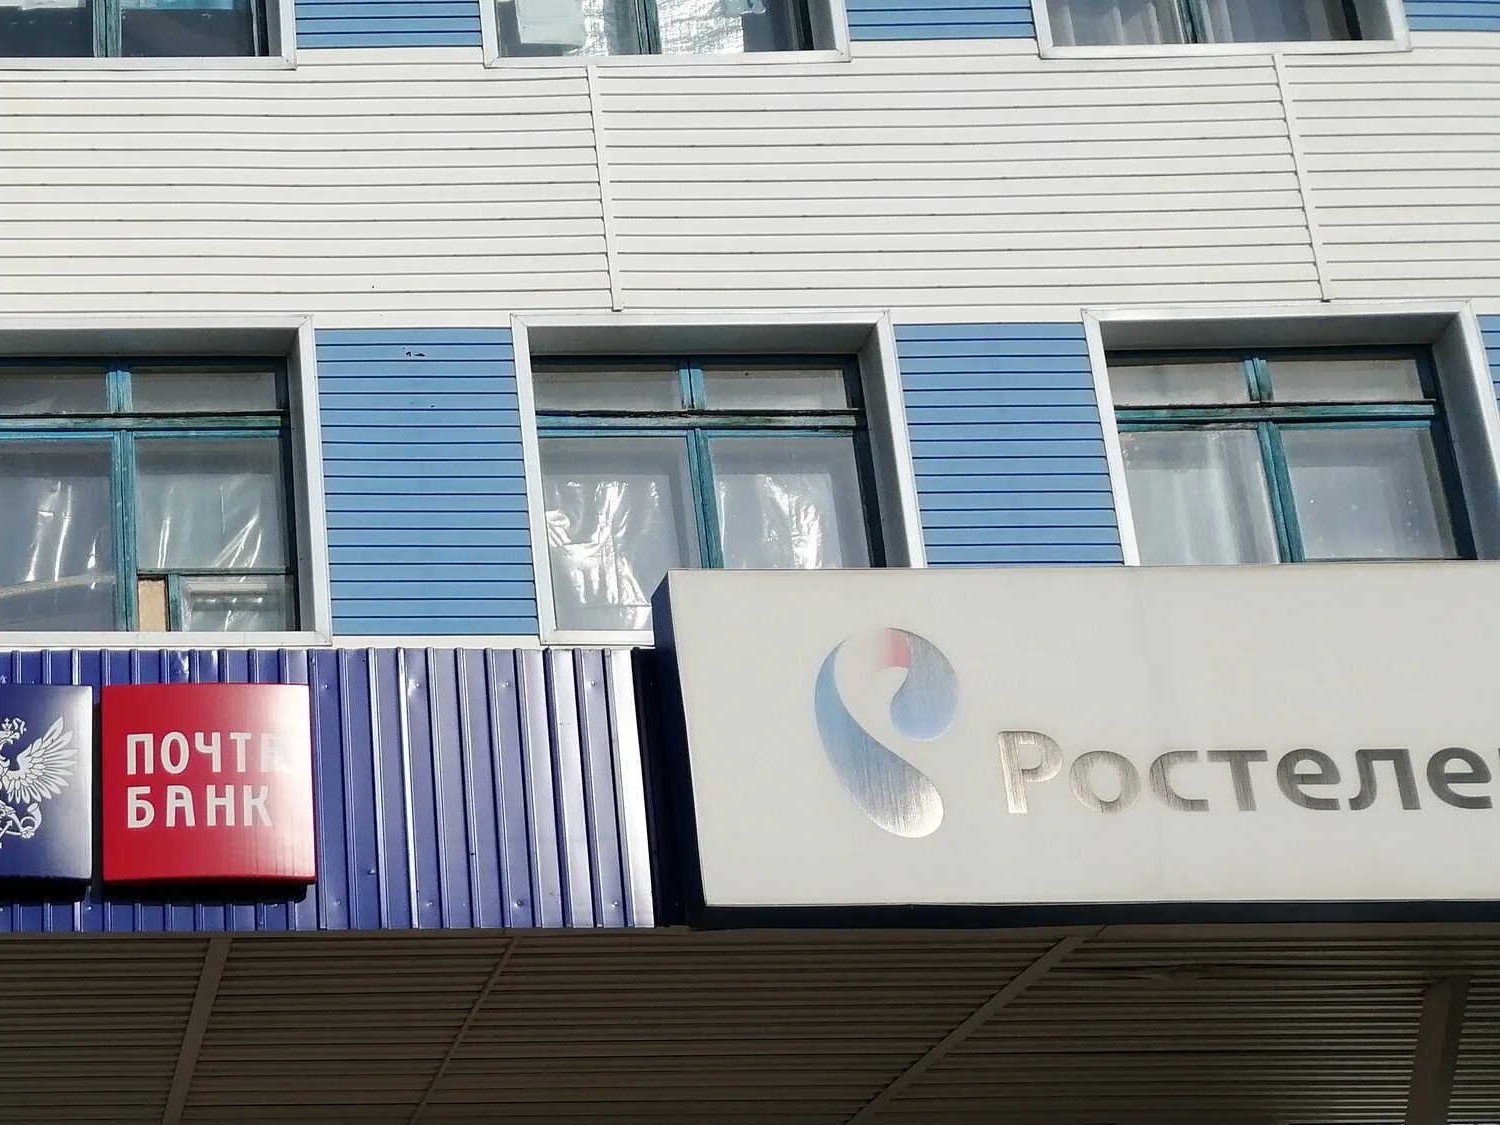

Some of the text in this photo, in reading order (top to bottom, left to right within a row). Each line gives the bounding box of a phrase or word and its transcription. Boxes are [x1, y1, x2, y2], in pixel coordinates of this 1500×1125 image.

[127, 731, 292, 775] ПОЧТА
[997, 730, 1500, 814] Ростеле
[127, 785, 273, 828] БАНК
